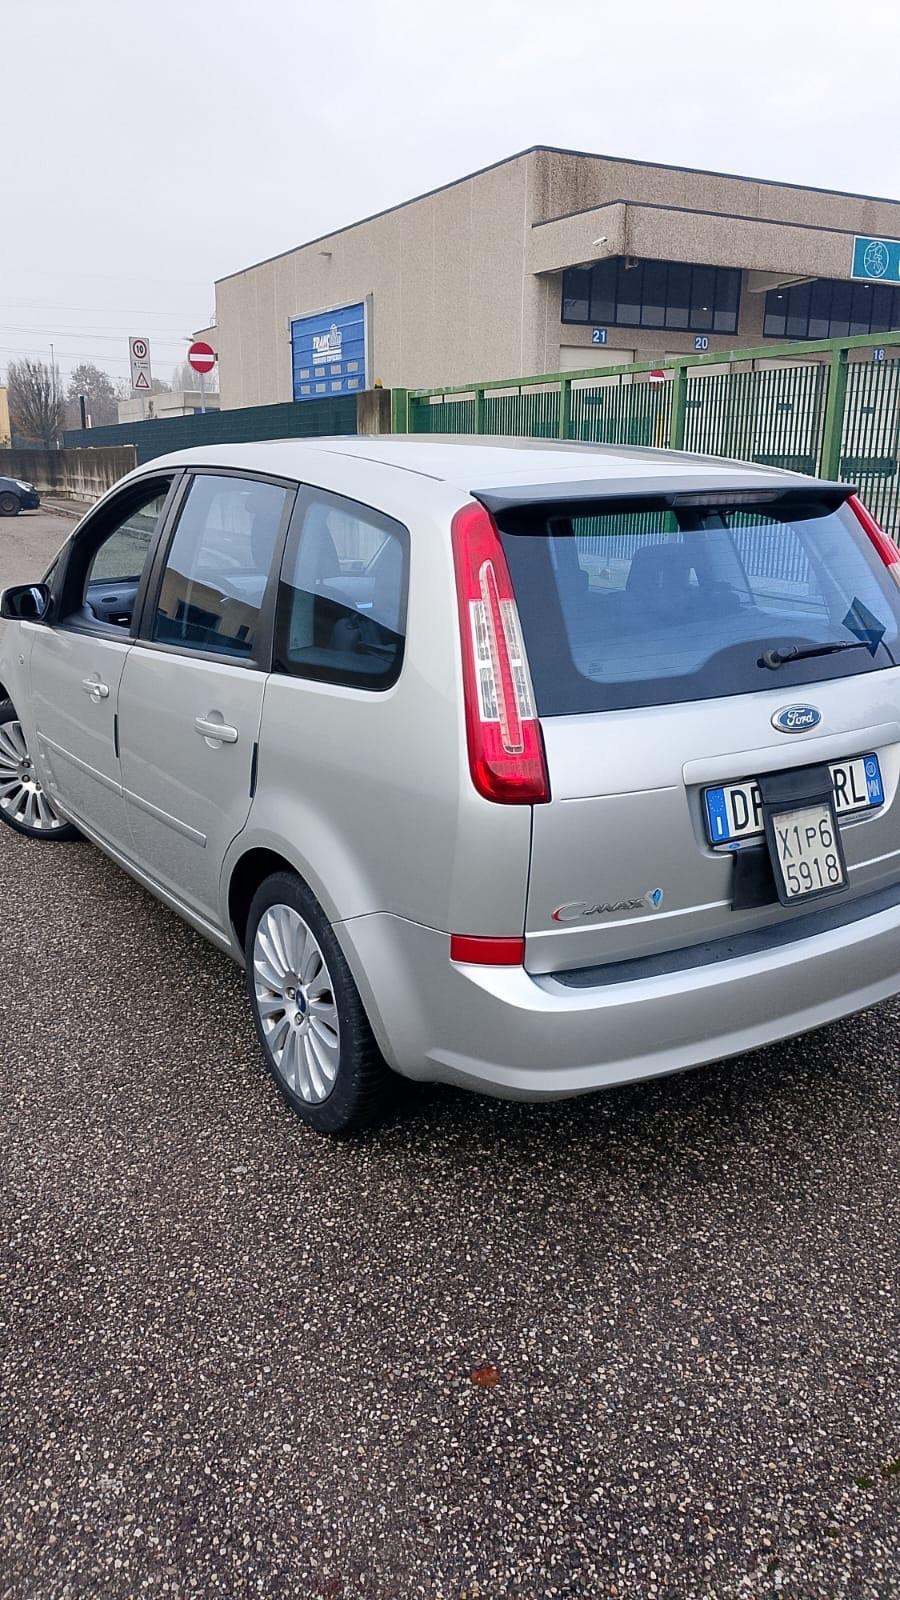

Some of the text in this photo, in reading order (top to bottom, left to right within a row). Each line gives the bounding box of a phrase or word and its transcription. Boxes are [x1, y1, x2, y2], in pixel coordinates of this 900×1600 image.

[592, 330, 606, 343] 21
[695, 337, 708, 349] 20
[136, 344, 144, 354] 10
[873, 349, 884, 361] 18
[787, 709, 814, 726] Ford
[833, 766, 866, 807] RL
[778, 819, 833, 860] X1P6
[786, 854, 839, 893] 5918
